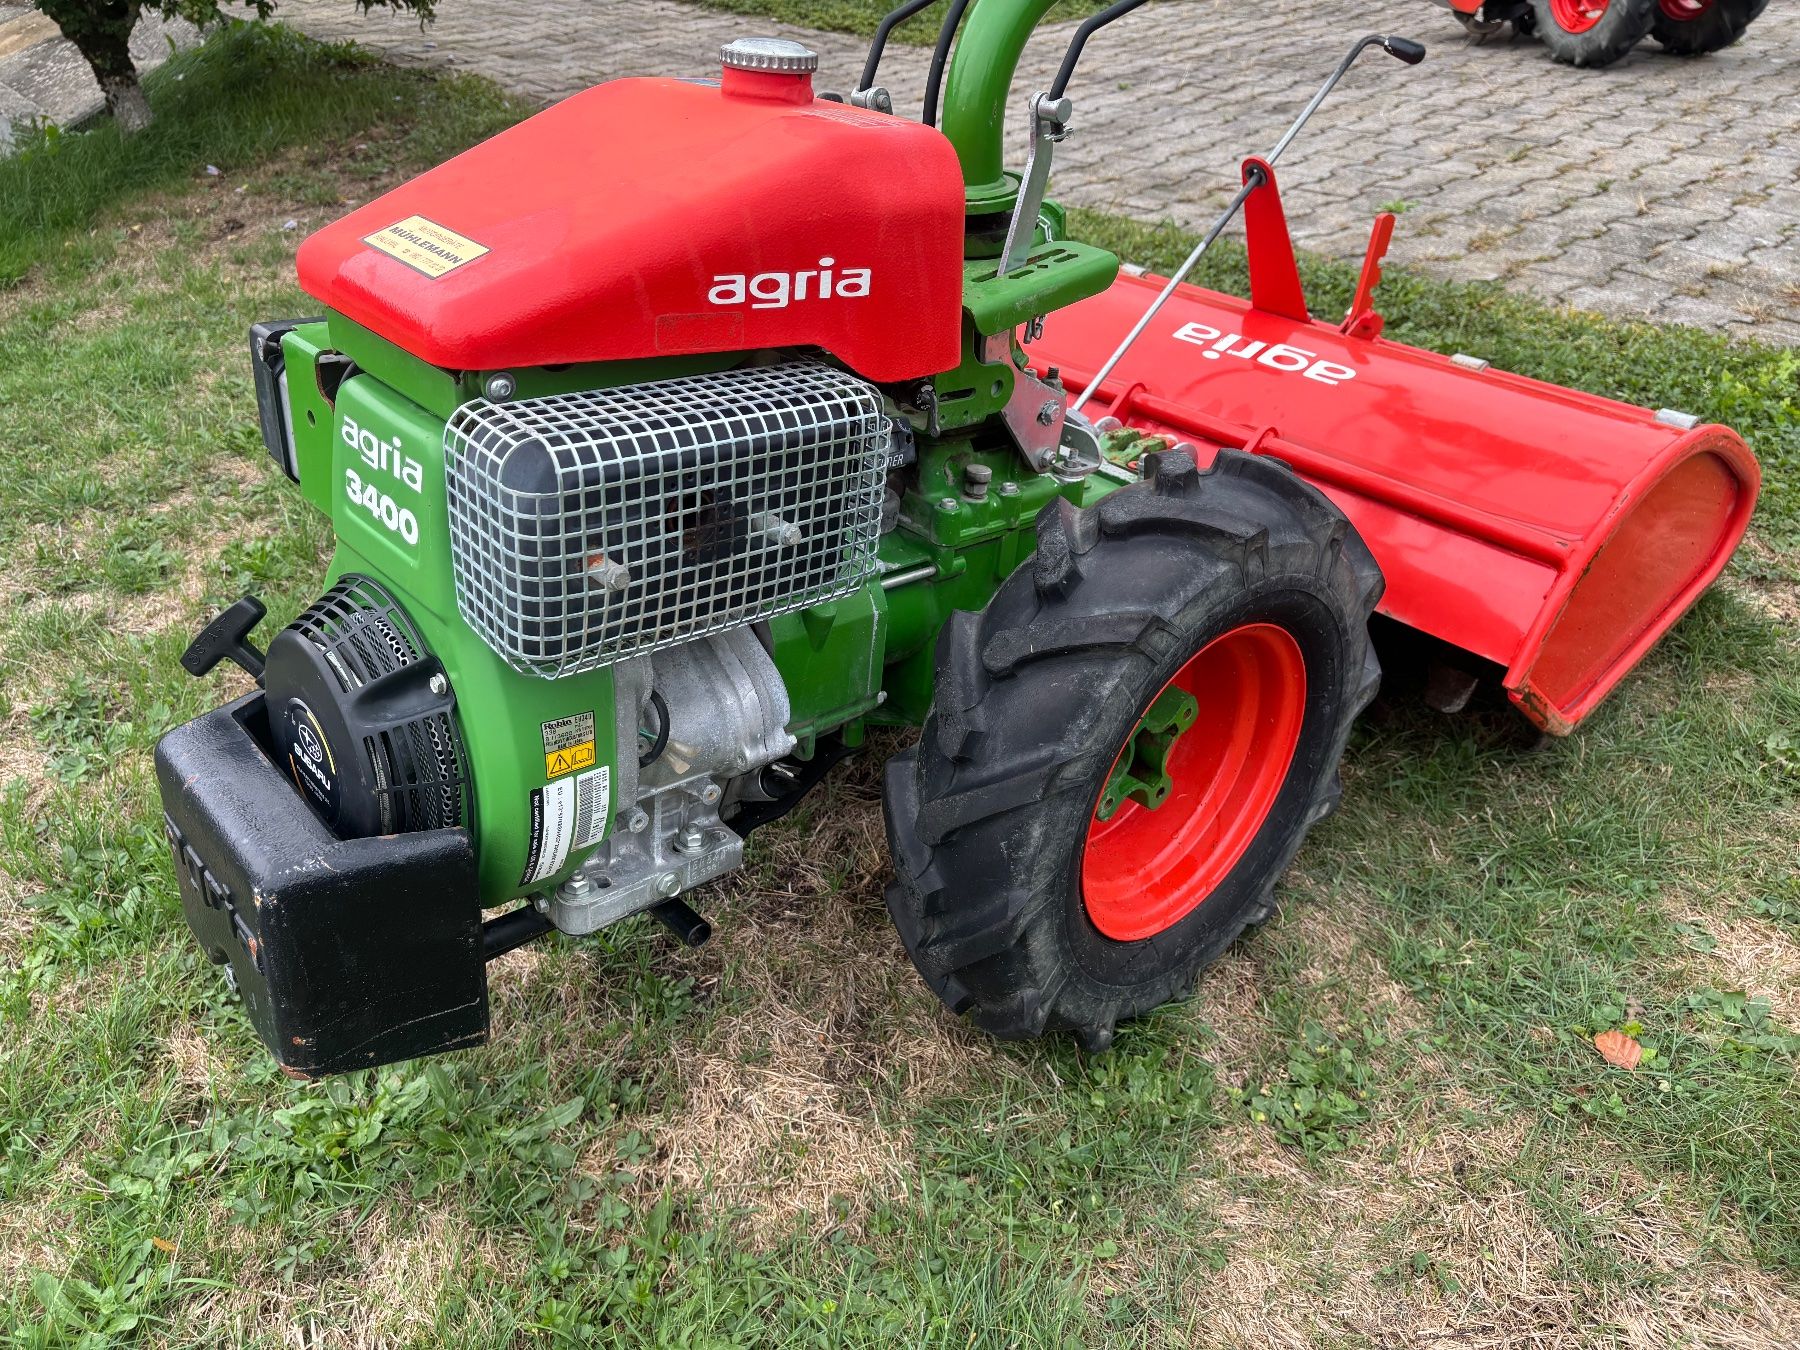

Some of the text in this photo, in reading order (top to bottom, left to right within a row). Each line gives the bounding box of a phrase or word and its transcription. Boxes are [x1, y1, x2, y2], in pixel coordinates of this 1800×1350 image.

[389, 226, 463, 264] MÜHLEMANN
[707, 256, 872, 309] agria
[1171, 321, 1357, 385] agria
[341, 414, 423, 494] agria
[345, 468, 419, 545] 3400
[293, 742, 331, 791] SUBARU
